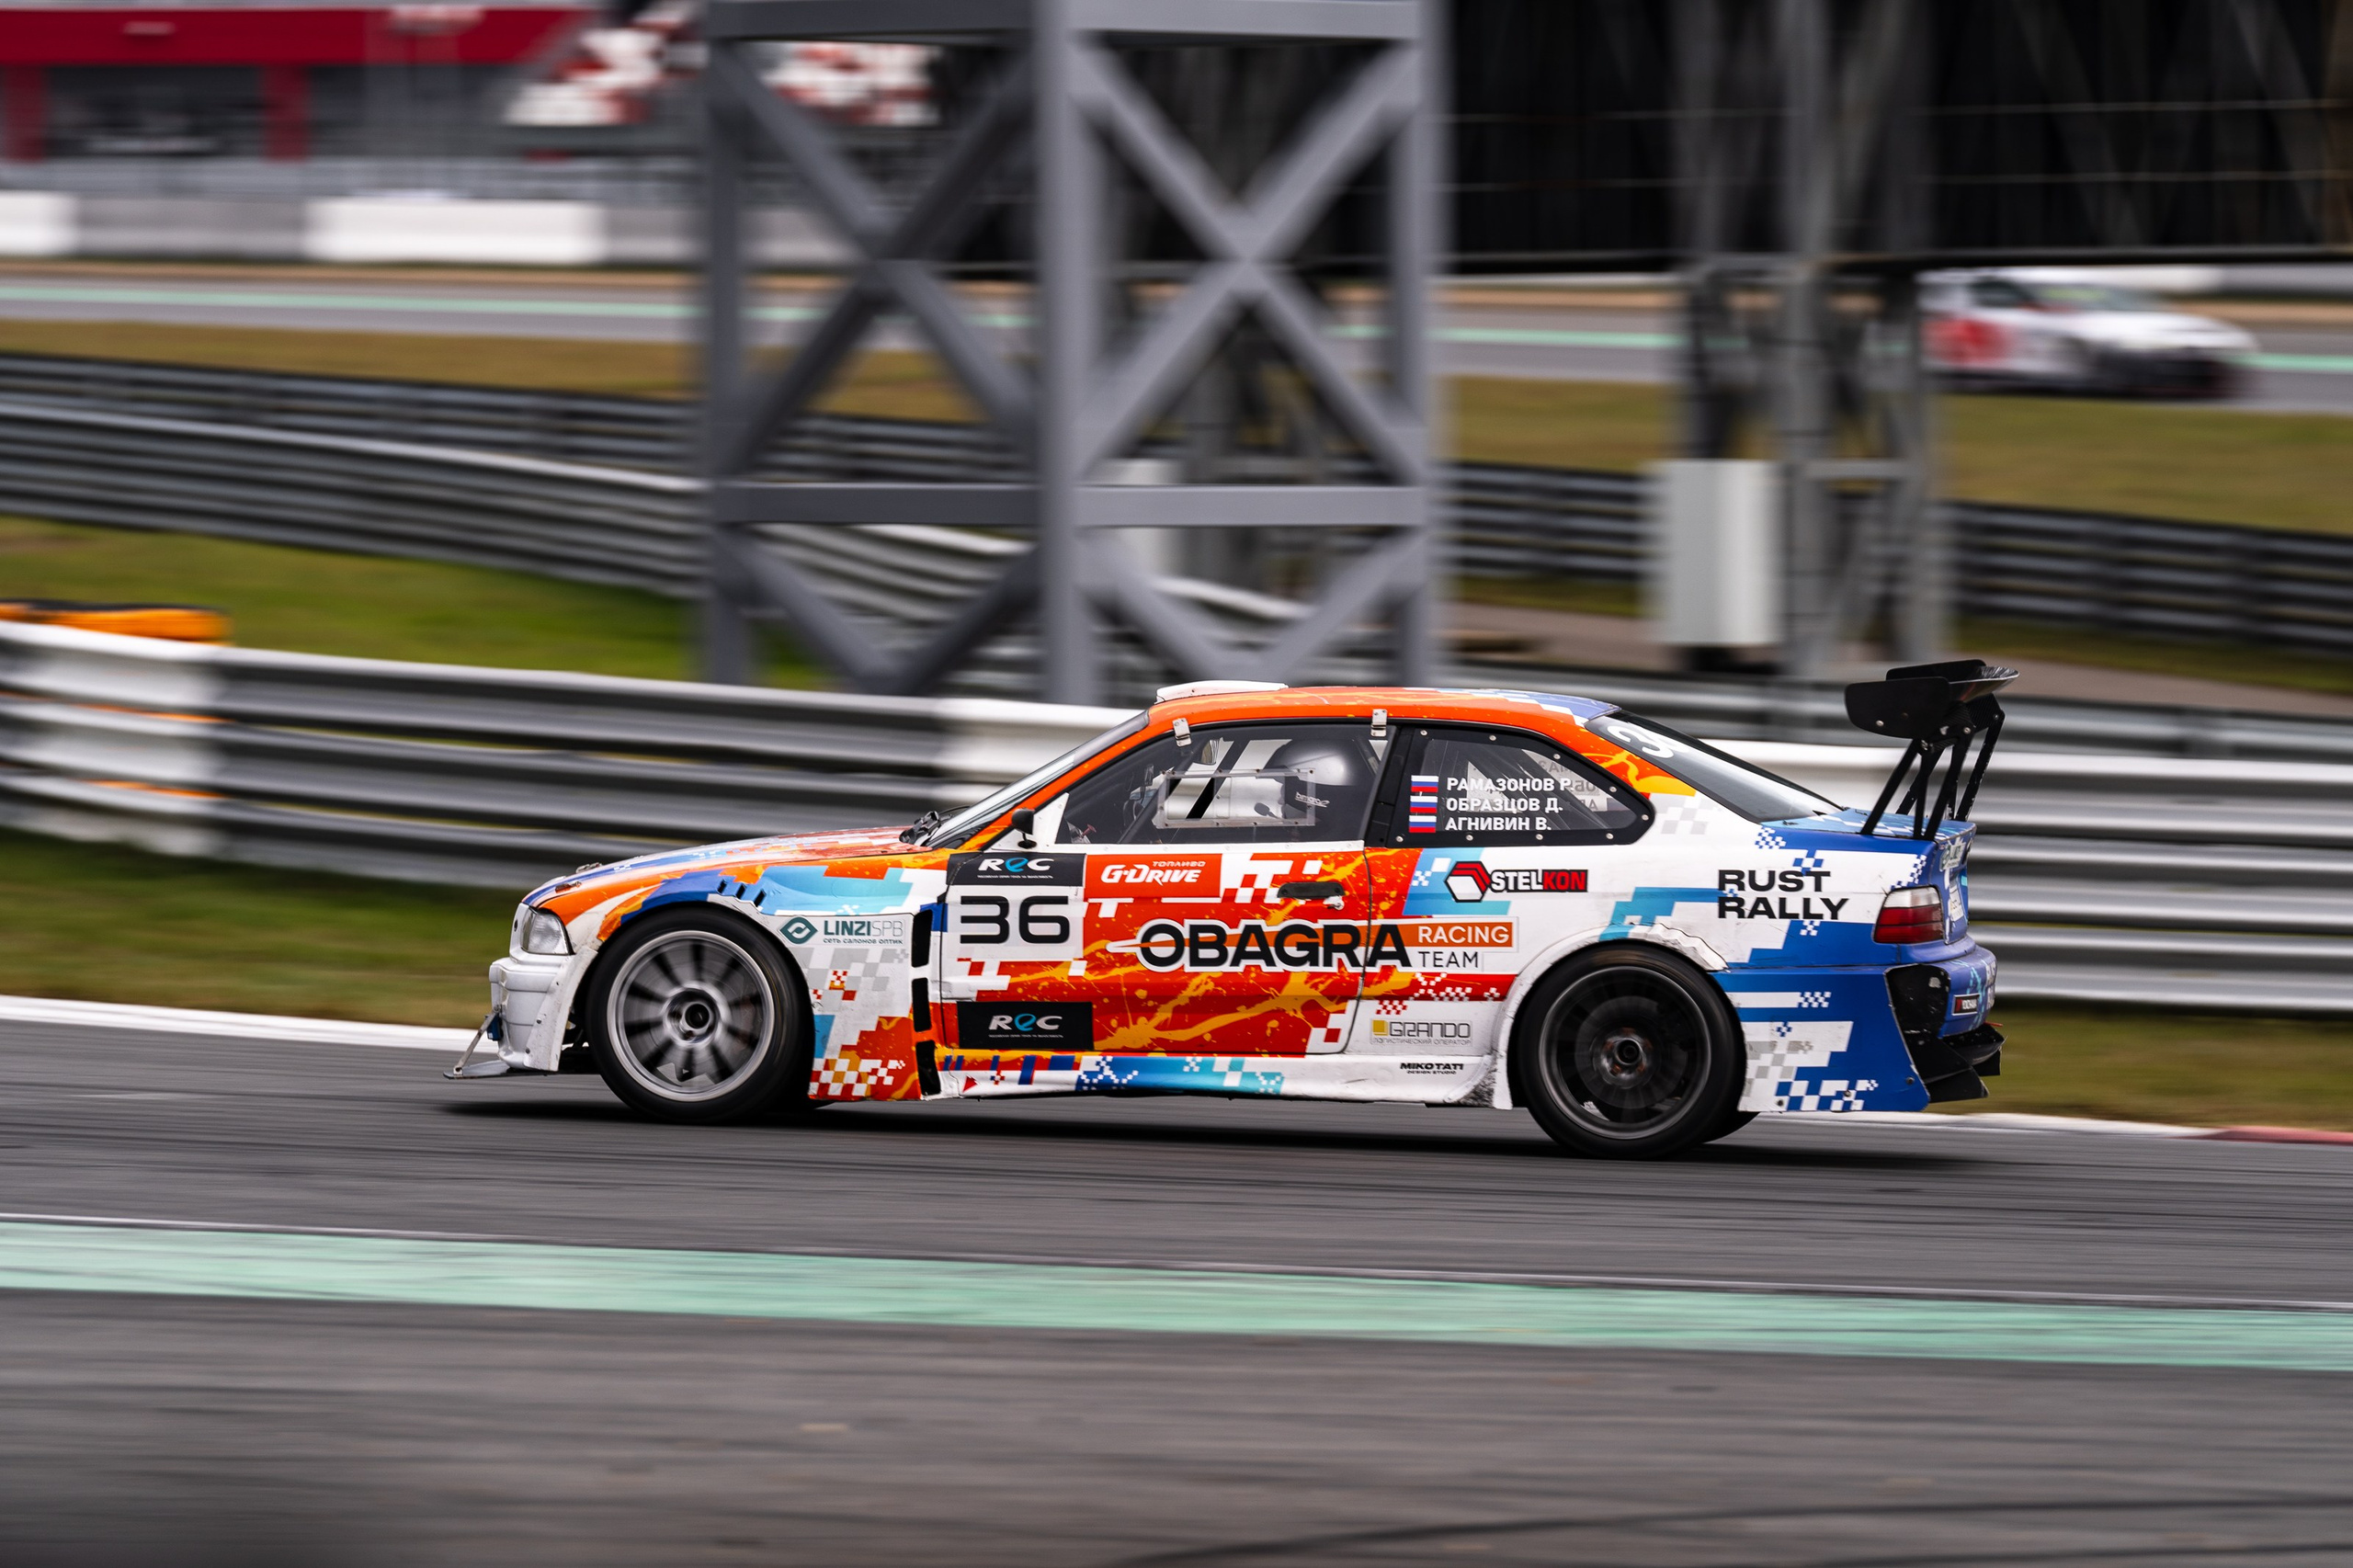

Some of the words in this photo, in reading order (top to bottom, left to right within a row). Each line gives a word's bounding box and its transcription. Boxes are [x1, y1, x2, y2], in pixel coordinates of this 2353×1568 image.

[1447, 777, 1555, 792] РАМАЗОНОВ
[1559, 778, 1574, 791] Р.
[1446, 797, 1541, 814] ОБРАЗЦОВ
[1544, 798, 1563, 813] Д.
[1444, 817, 1530, 831] АГНИВИН
[1535, 817, 1552, 831] В.
[1491, 869, 1588, 892] STELKON
[1718, 869, 1832, 893] RUST
[1718, 897, 1849, 920] RALLY
[960, 894, 1072, 944] 36
[1418, 926, 1510, 944] RACING
[1140, 923, 1413, 969] OBAGRA
[1418, 950, 1480, 969] TEAM
[1389, 1021, 1471, 1039] GRANDO
